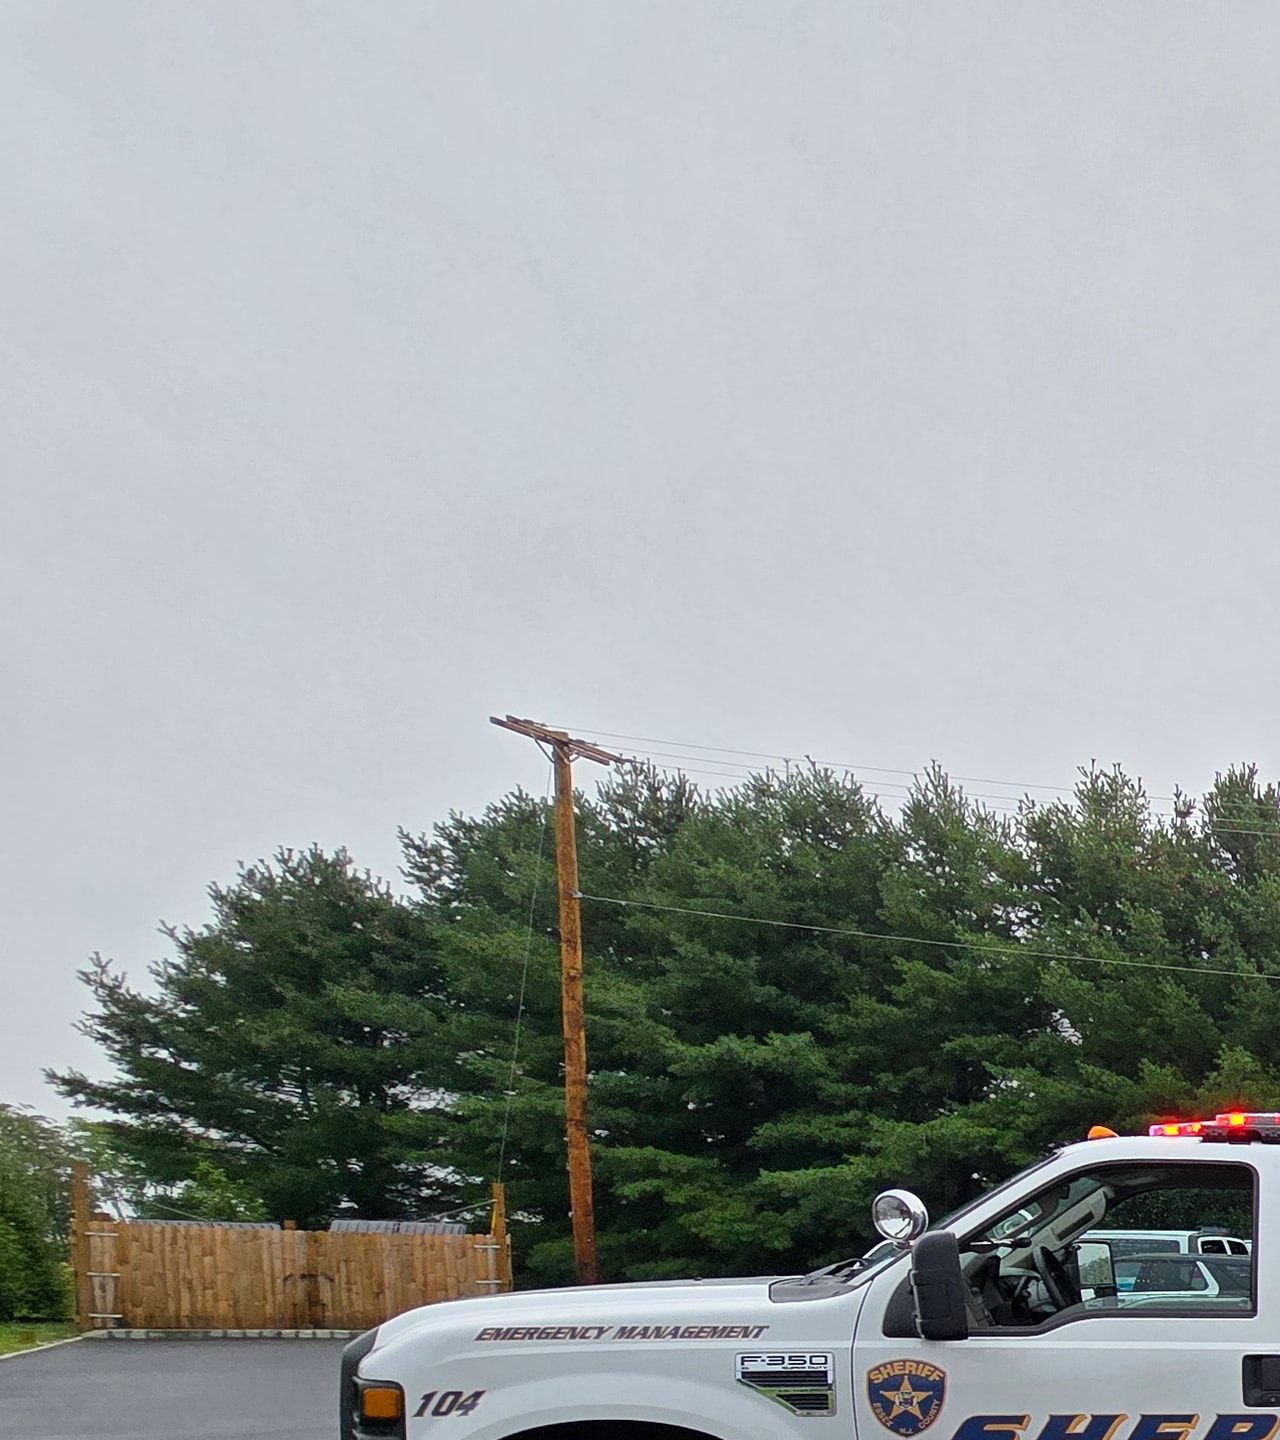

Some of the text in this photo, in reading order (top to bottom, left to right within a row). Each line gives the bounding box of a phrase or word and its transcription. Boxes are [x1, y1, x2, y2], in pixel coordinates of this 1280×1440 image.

[474, 1325, 770, 1342] EMERGENCY MANAGEMENT
[740, 1355, 828, 1366] F-350
[869, 1361, 944, 1384] SHERIFF
[411, 1389, 488, 1418] 104
[918, 1399, 941, 1429] COUNTY
